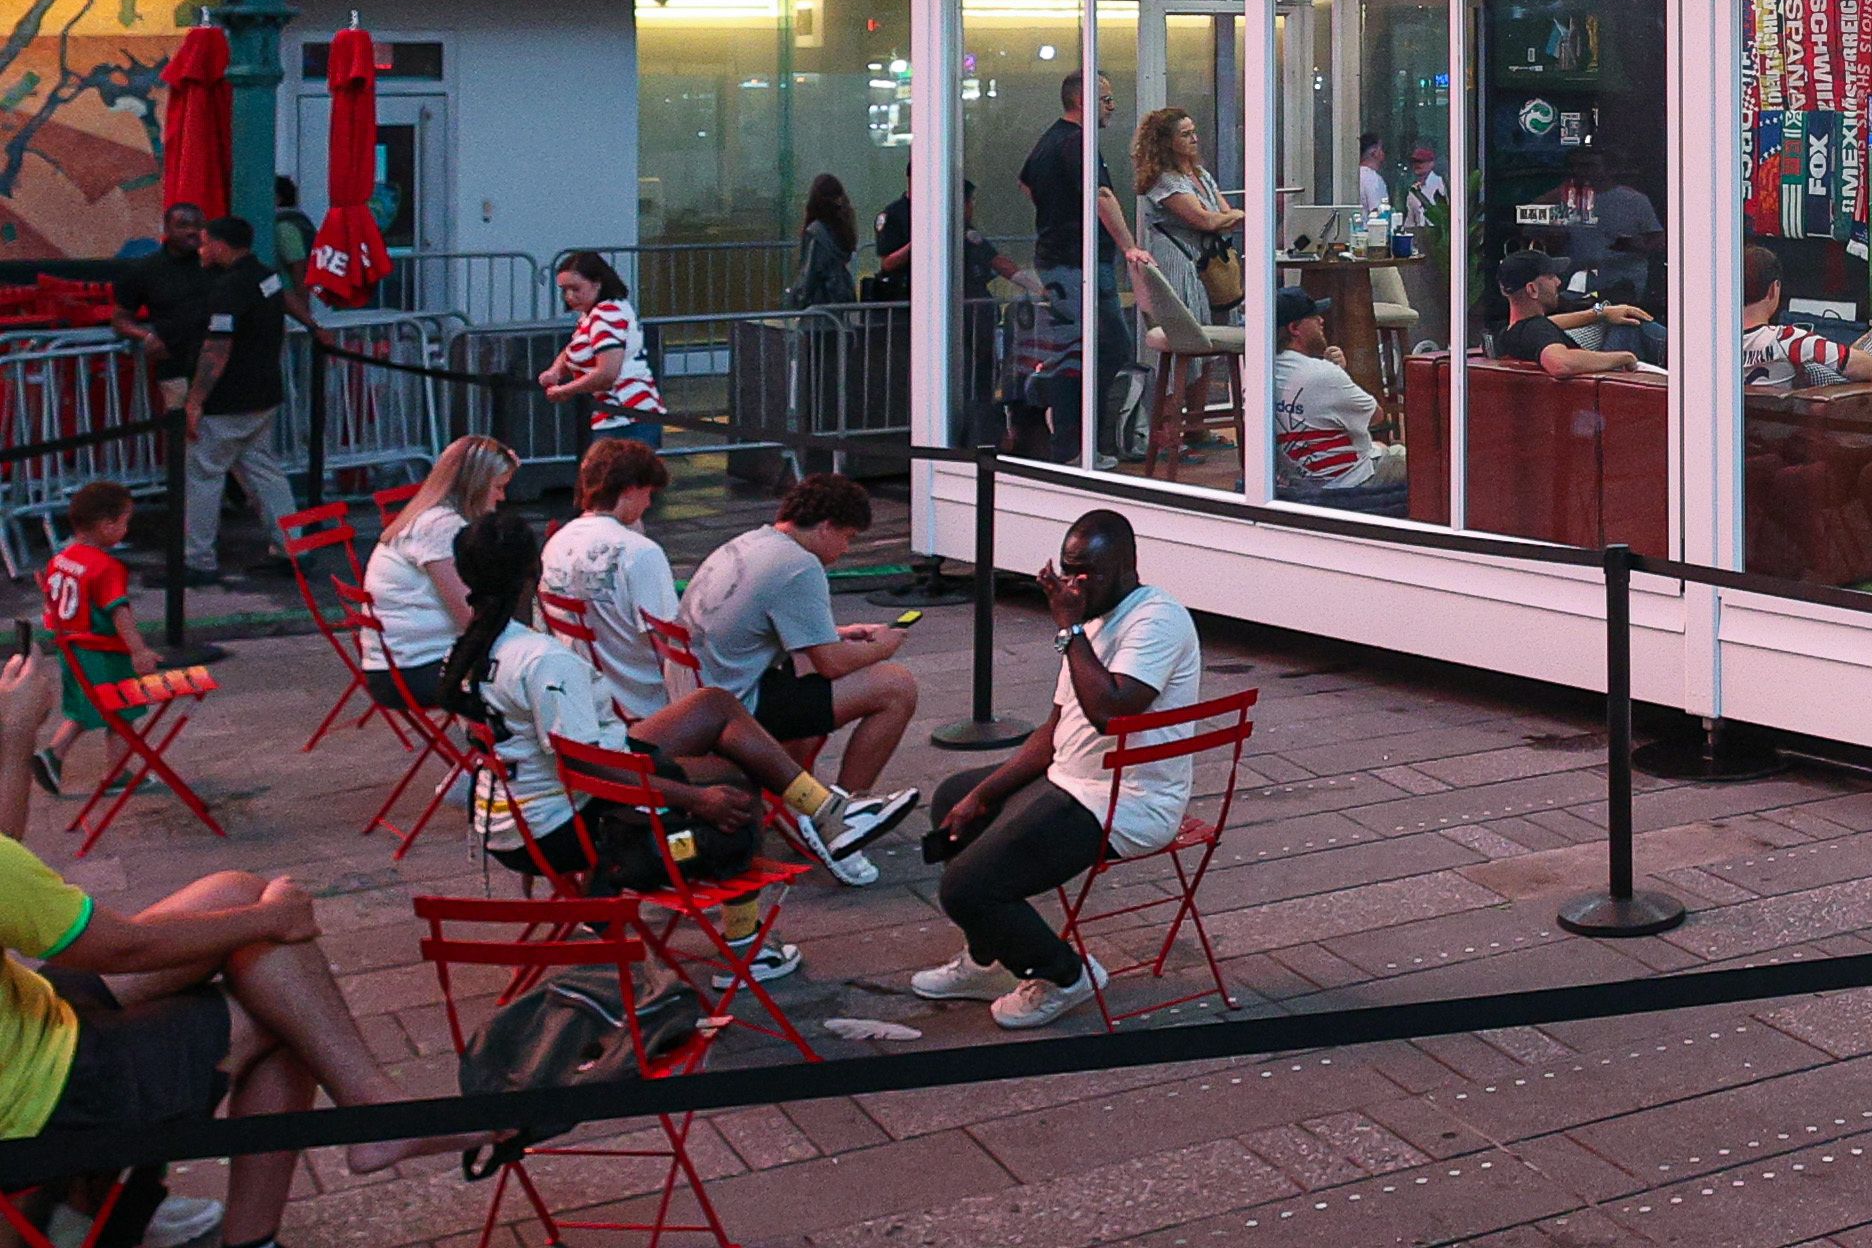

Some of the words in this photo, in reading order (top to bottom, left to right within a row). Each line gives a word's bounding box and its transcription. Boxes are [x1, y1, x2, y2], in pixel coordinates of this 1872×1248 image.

[1808, 133, 1829, 196] FOX
[1841, 109, 1859, 202] MEXI
[47, 571, 79, 620] 10
